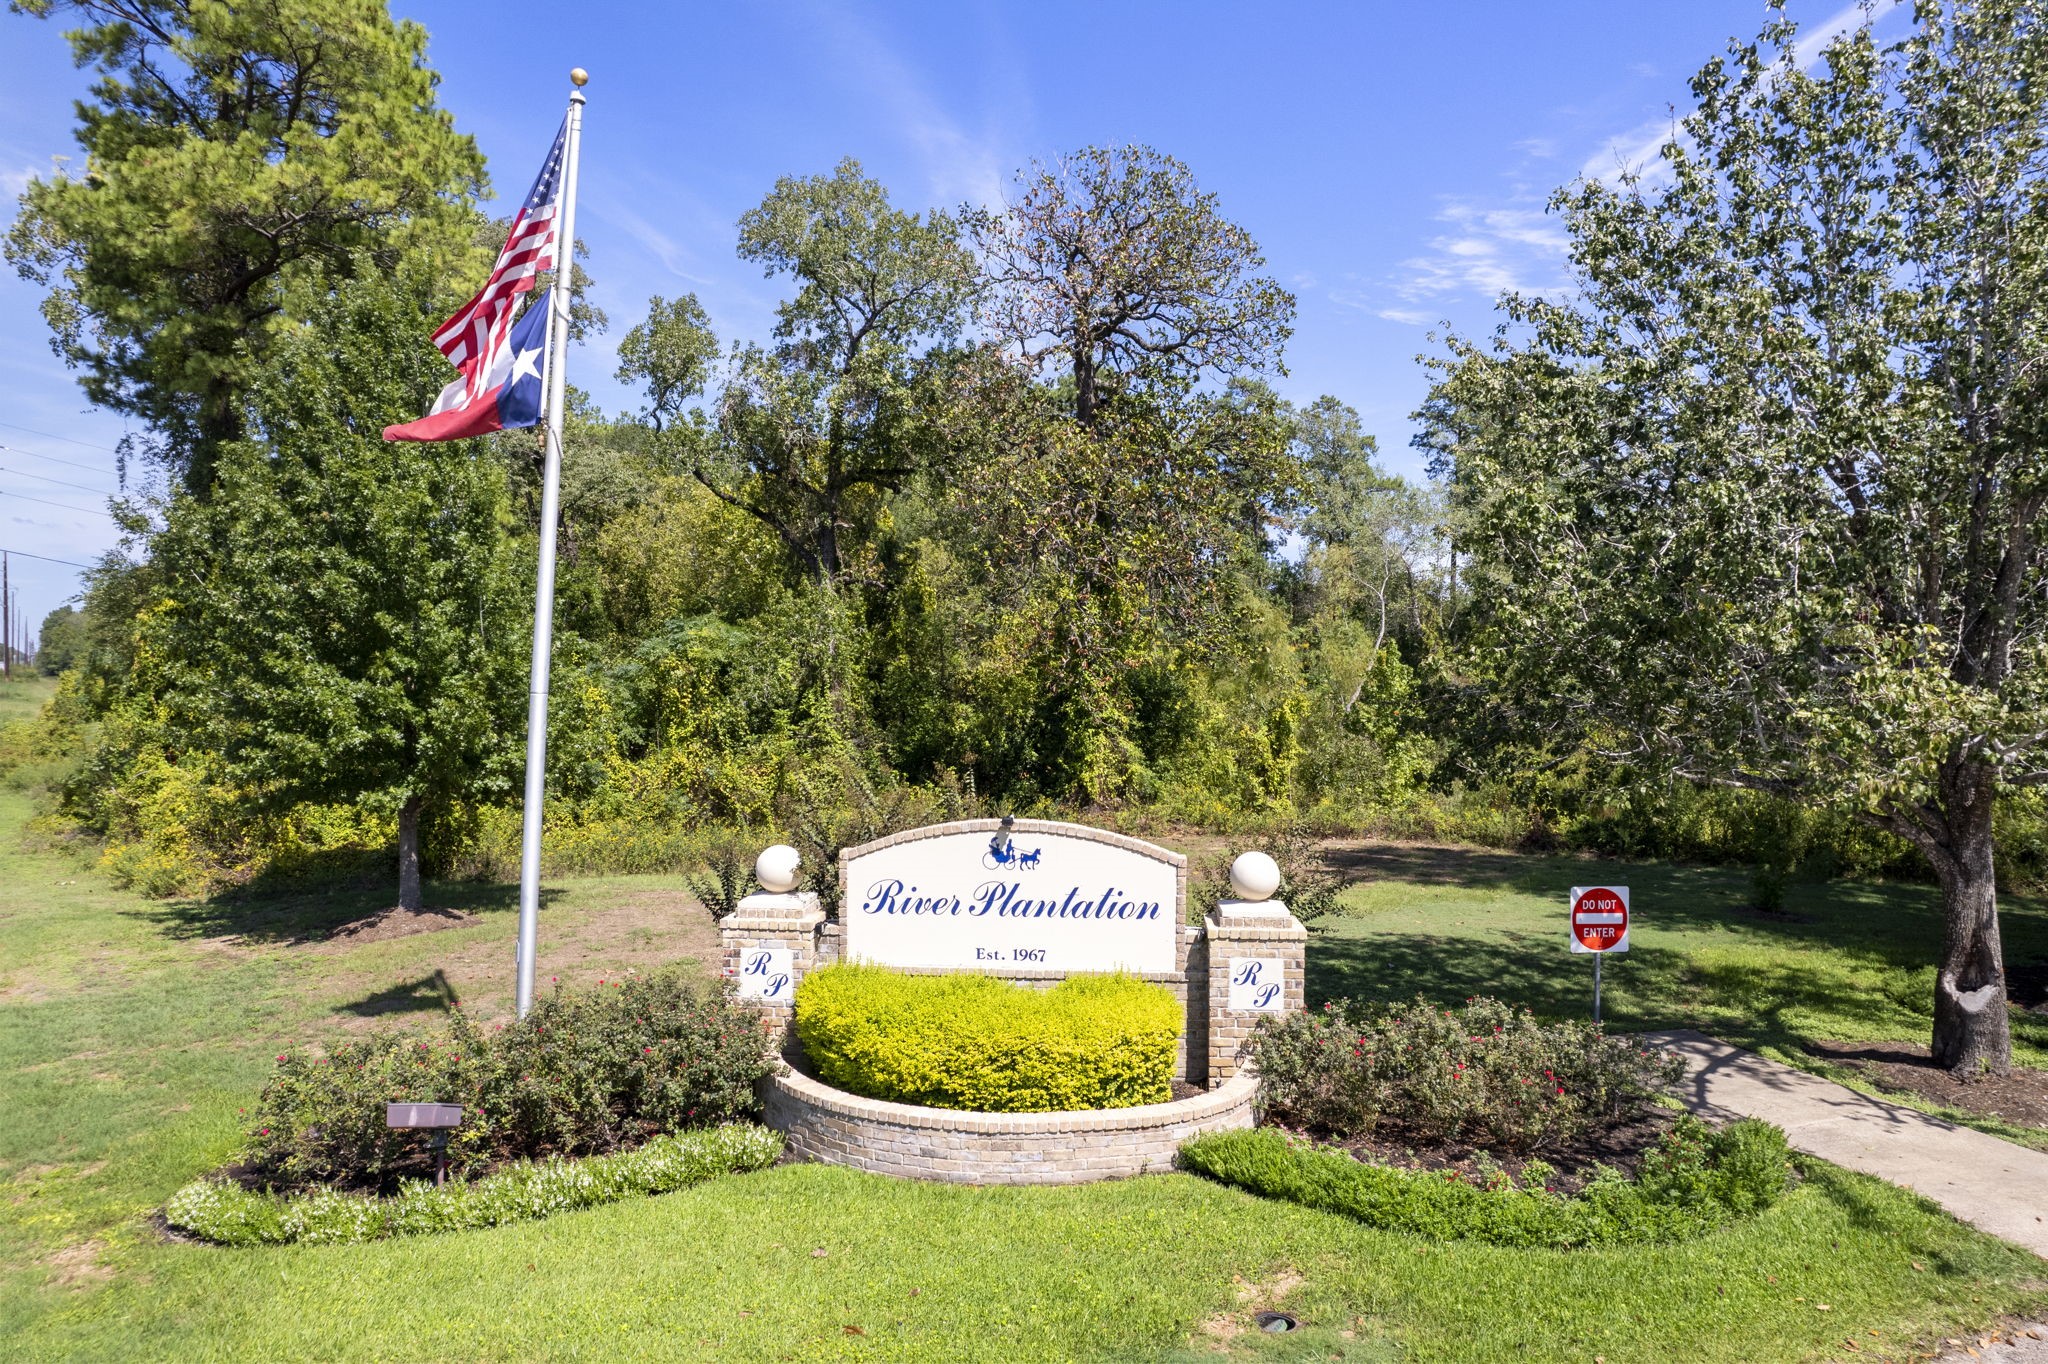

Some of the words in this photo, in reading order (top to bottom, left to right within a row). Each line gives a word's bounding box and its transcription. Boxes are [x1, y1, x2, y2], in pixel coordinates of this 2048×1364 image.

[863, 878, 962, 916] River
[968, 880, 1161, 920] Plantation
[1582, 899, 1596, 910] DO
[1597, 899, 1617, 910] NOT
[1583, 927, 1615, 938] ENTER
[744, 951, 772, 975] R
[975, 947, 1006, 961] Est.
[1013, 947, 1046, 962] 1967
[763, 972, 789, 997] P
[1233, 960, 1262, 986] R
[1253, 982, 1280, 1008] P
